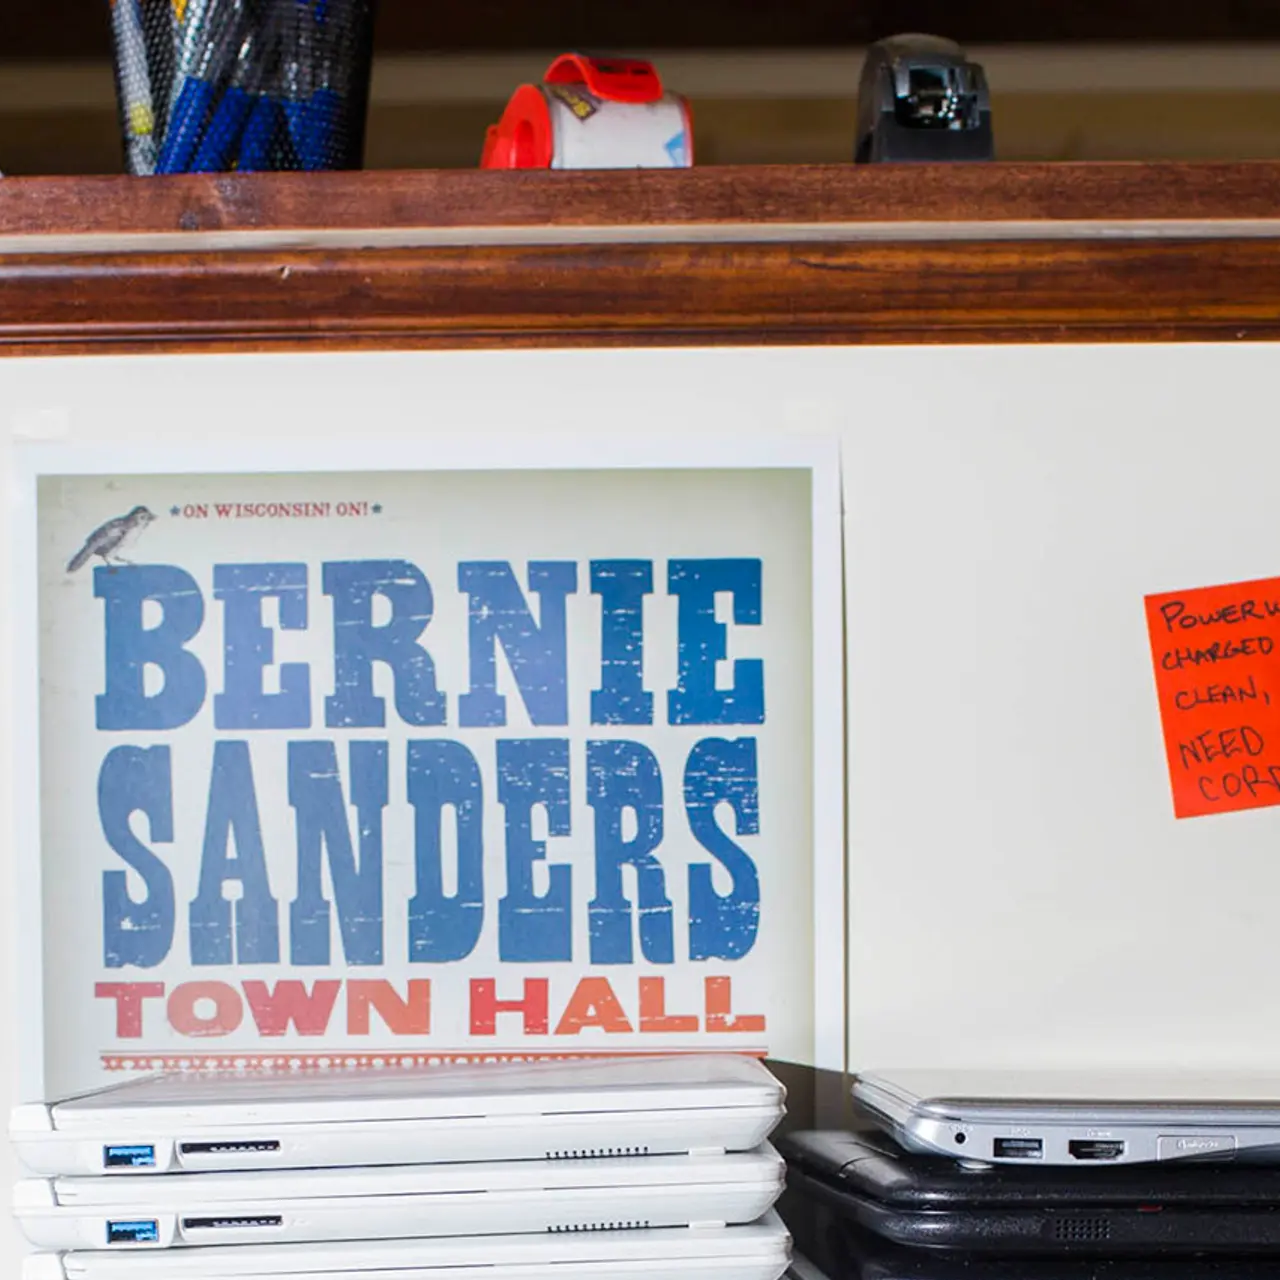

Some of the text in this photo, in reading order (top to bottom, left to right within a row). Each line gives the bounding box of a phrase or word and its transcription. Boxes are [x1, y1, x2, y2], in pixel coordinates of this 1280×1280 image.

[183, 501, 369, 518] ON WISCONSIN! ON!
[93, 558, 766, 731] BERNIE
[1175, 676, 1270, 710] CLEAN,
[1179, 725, 1265, 770] NEED
[96, 737, 762, 969] SANDERS
[94, 975, 767, 1039] TOWN HALL
